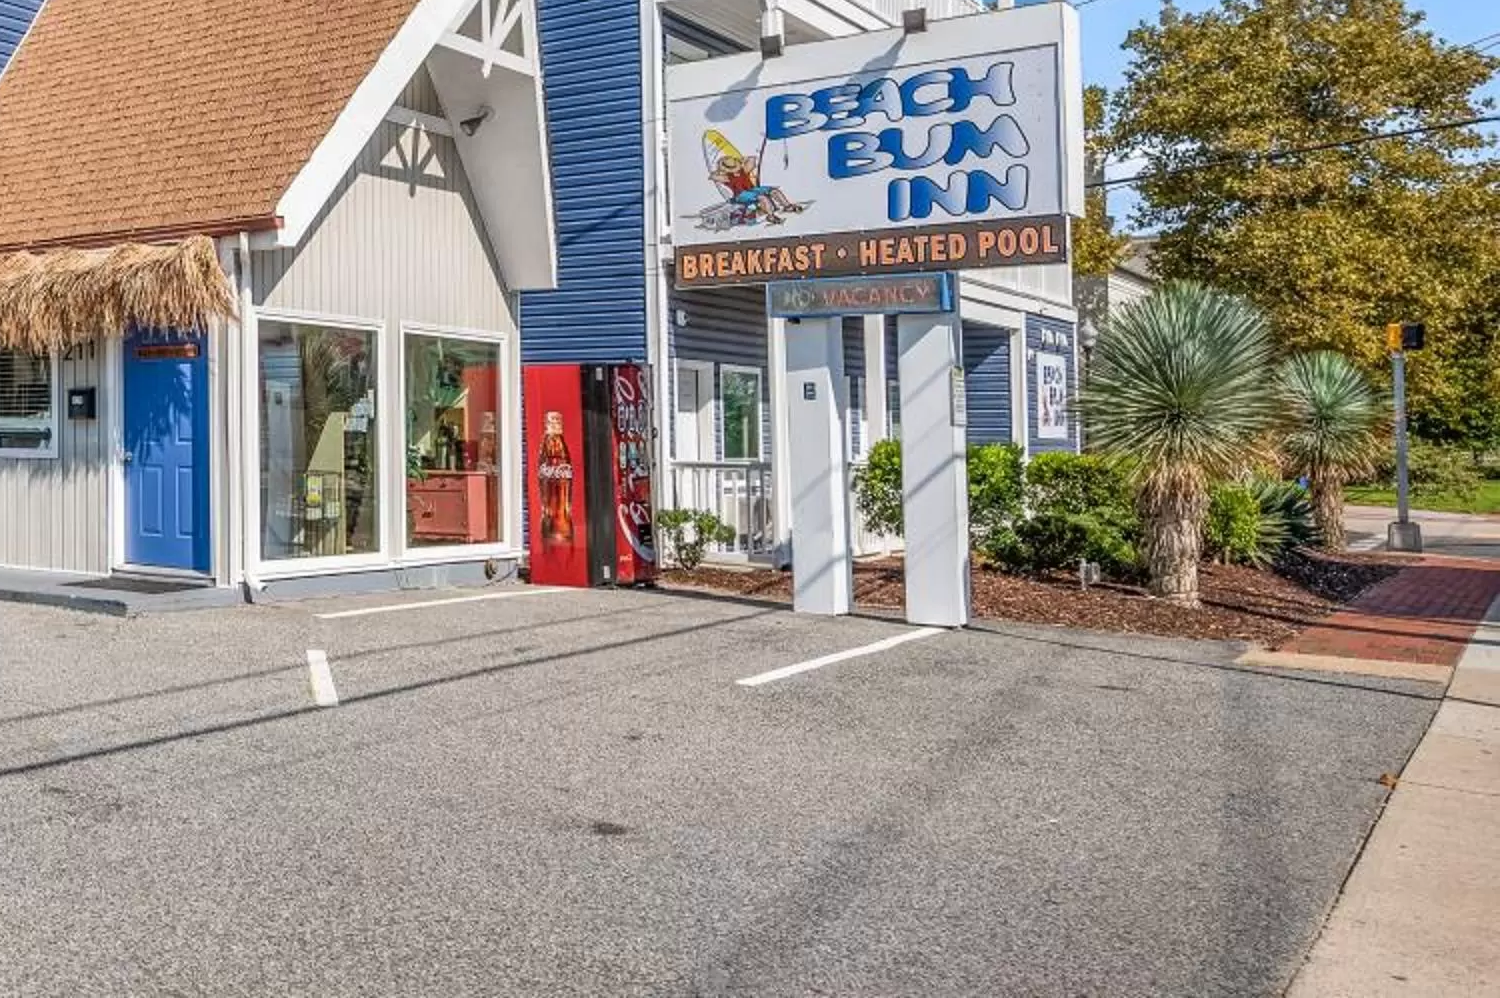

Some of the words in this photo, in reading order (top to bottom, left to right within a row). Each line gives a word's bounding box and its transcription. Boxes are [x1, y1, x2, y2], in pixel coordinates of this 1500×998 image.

[766, 61, 1017, 140] BEACH
[828, 114, 1030, 180] BUM
[888, 164, 1030, 221] INN
[682, 243, 826, 280] BREAKFAST
[858, 232, 967, 268] HEATED
[978, 225, 1060, 259] POOL
[823, 281, 930, 306] VACANCY
